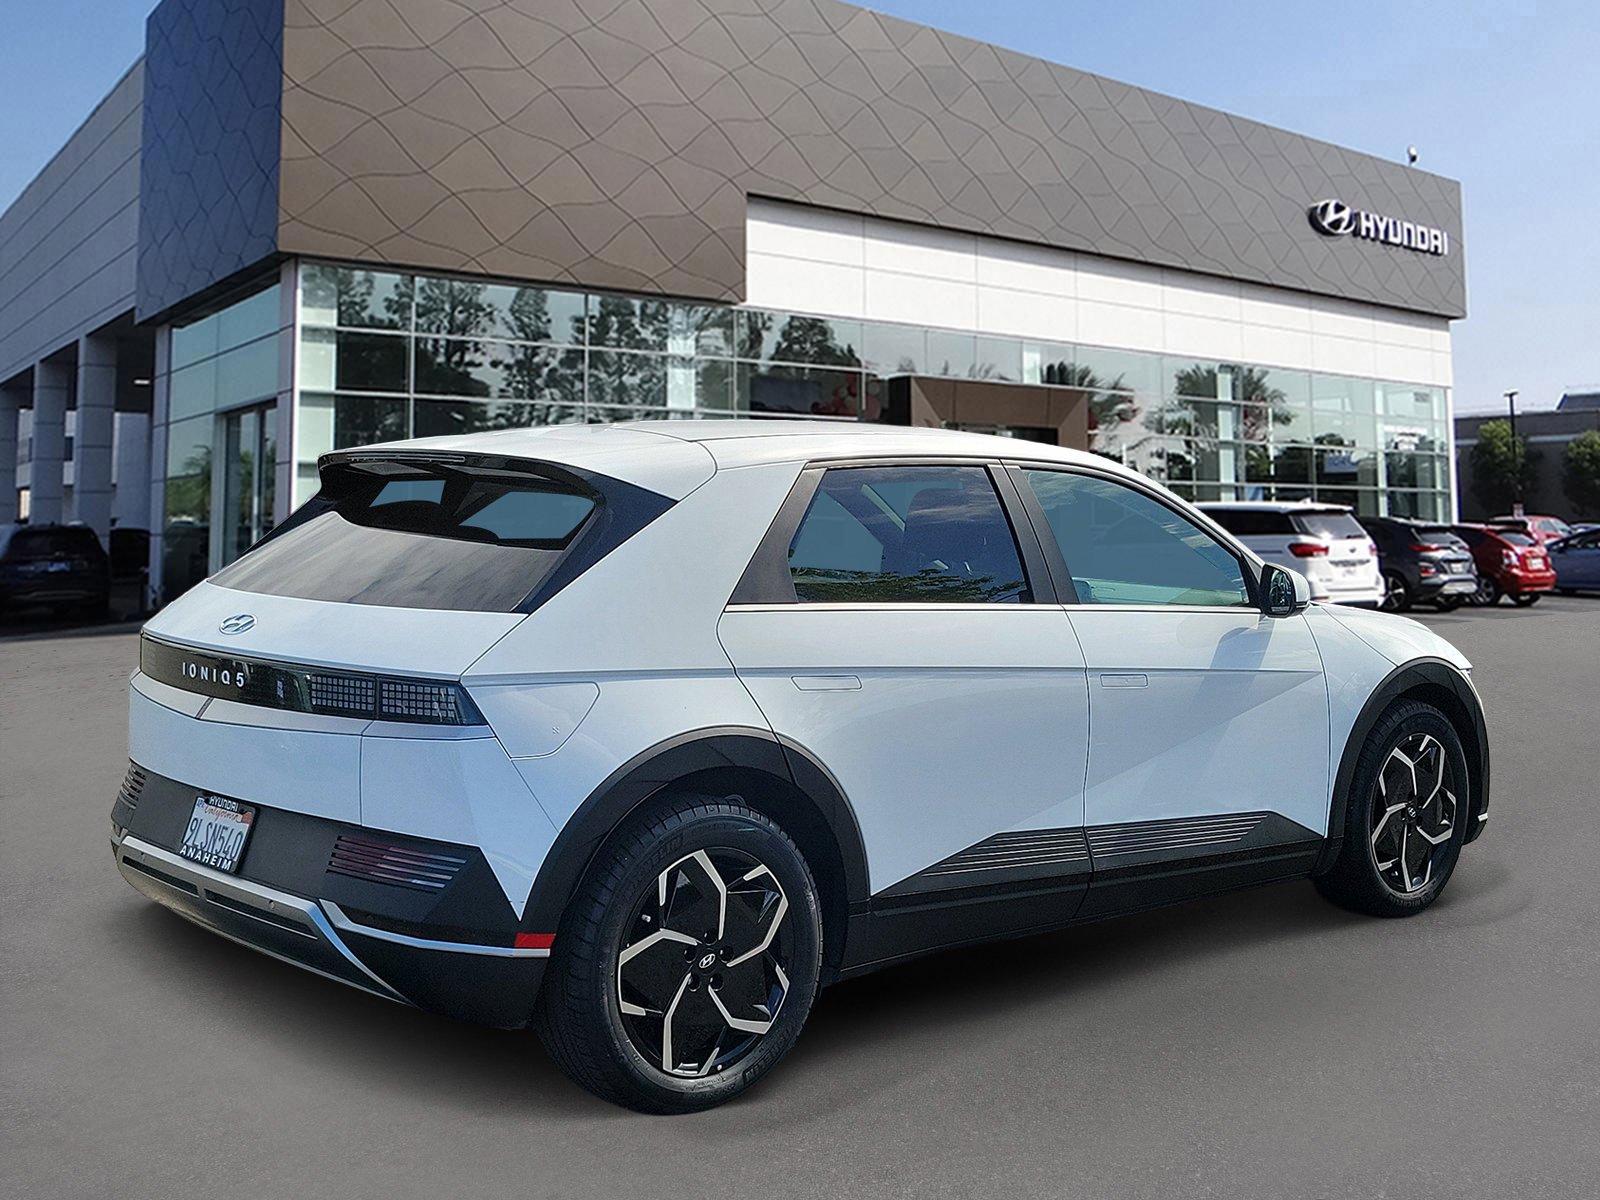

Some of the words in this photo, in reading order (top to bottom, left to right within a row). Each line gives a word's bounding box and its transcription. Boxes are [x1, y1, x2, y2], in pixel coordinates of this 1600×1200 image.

[1360, 211, 1449, 255] HYUNDAI
[182, 662, 231, 685] IONIQ
[236, 672, 245, 687] 5
[209, 796, 239, 812] HYUNDAI
[180, 845, 232, 871] ANAHEIM
